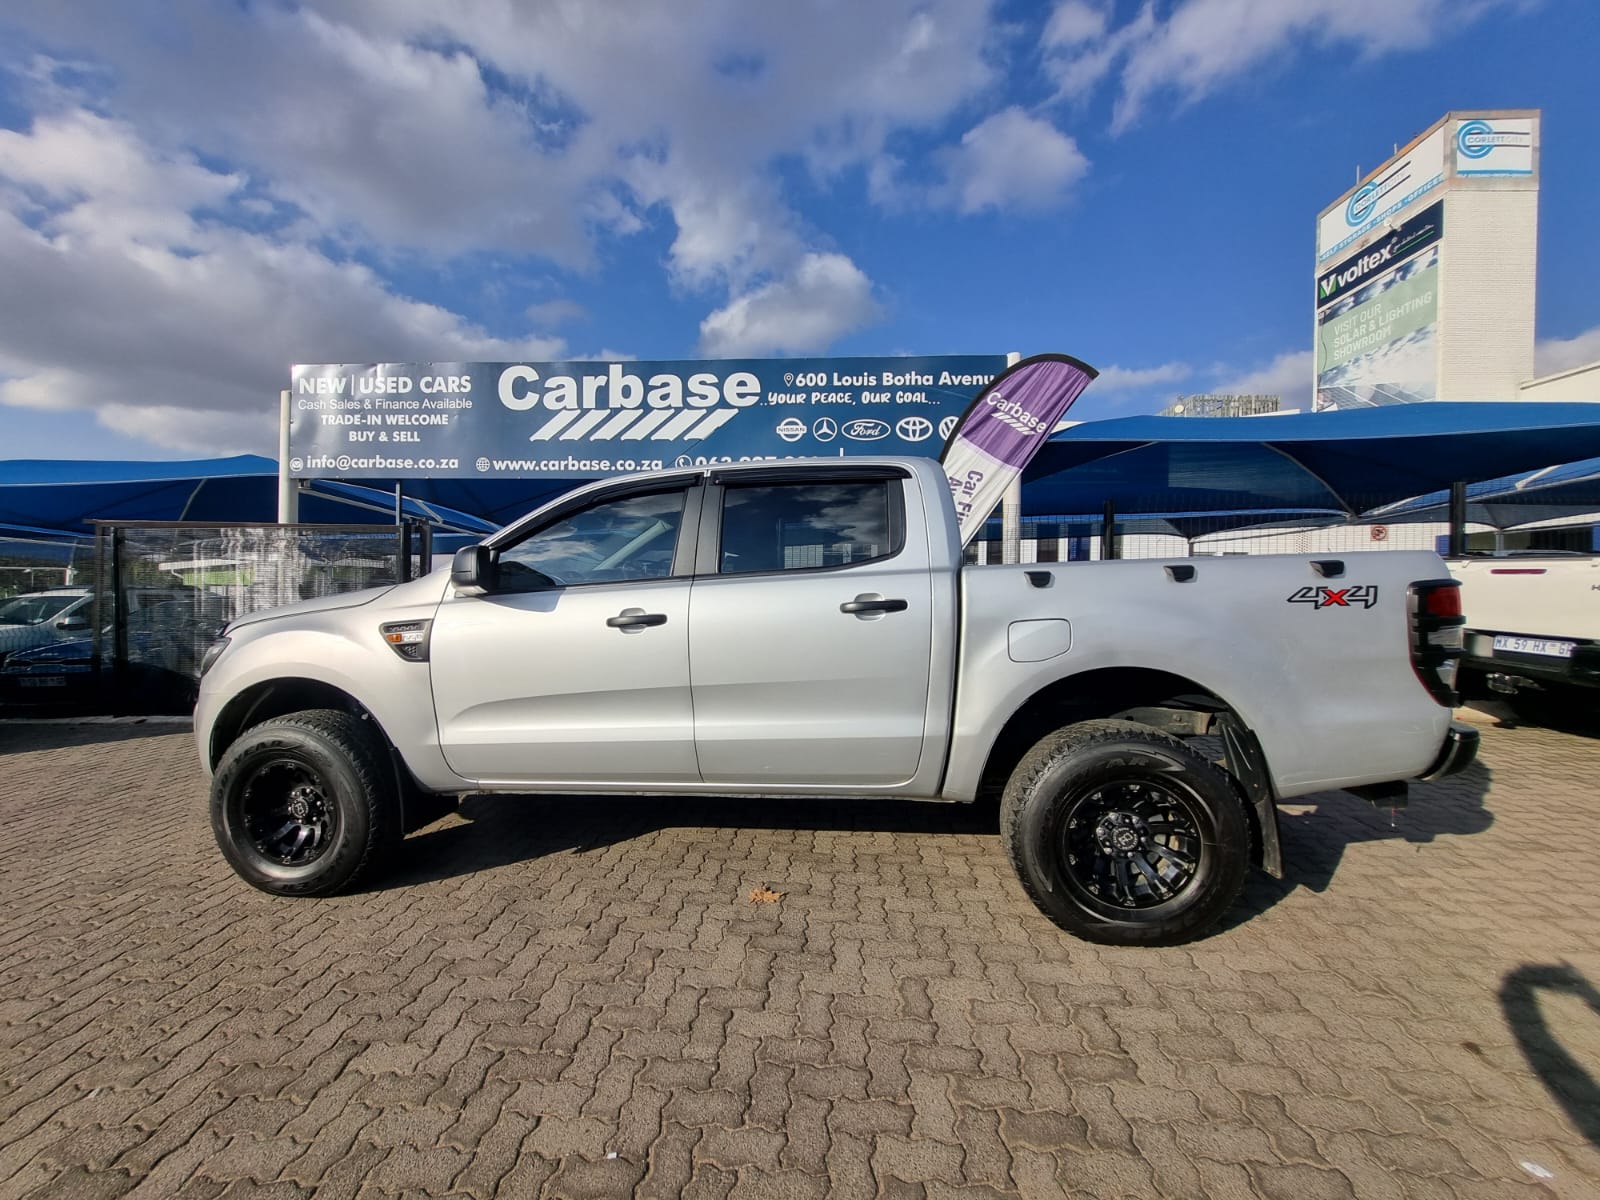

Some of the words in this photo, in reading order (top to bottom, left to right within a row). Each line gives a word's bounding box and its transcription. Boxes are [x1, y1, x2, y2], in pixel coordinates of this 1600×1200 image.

[1467, 136, 1504, 144] CORLETT
[1338, 244, 1393, 287] voltex
[1334, 316, 1357, 335] VISIT
[1360, 304, 1382, 321] OUR
[1334, 324, 1367, 349] SOLAR
[1368, 319, 1377, 332] &
[1379, 291, 1433, 326] LIGHTING
[1334, 326, 1392, 361] SHOWROOM
[300, 377, 346, 394] NEW
[359, 376, 412, 394] USED
[419, 376, 472, 393] CARS
[796, 372, 827, 387] 600
[833, 372, 877, 387] Louis
[882, 371, 934, 387] Botha
[939, 371, 995, 386] Avenu
[498, 364, 761, 411] Carbase
[298, 399, 326, 410] Cash
[330, 399, 361, 410] Sales
[364, 400, 372, 410] &
[375, 399, 419, 409] Finance
[422, 398, 473, 409] Available
[321, 414, 382, 425] TRADE-IN
[385, 414, 449, 425] WELCOME
[986, 391, 1048, 434] Carbase
[349, 431, 375, 442] BUY
[379, 431, 388, 442] &
[392, 431, 421, 442] SELL
[777, 425, 806, 433] NISSAN
[850, 422, 881, 437] Ford
[306, 455, 459, 471] info@carbase.co.za
[493, 456, 663, 472] www.carbase.co.za
[962, 470, 983, 498] Car
